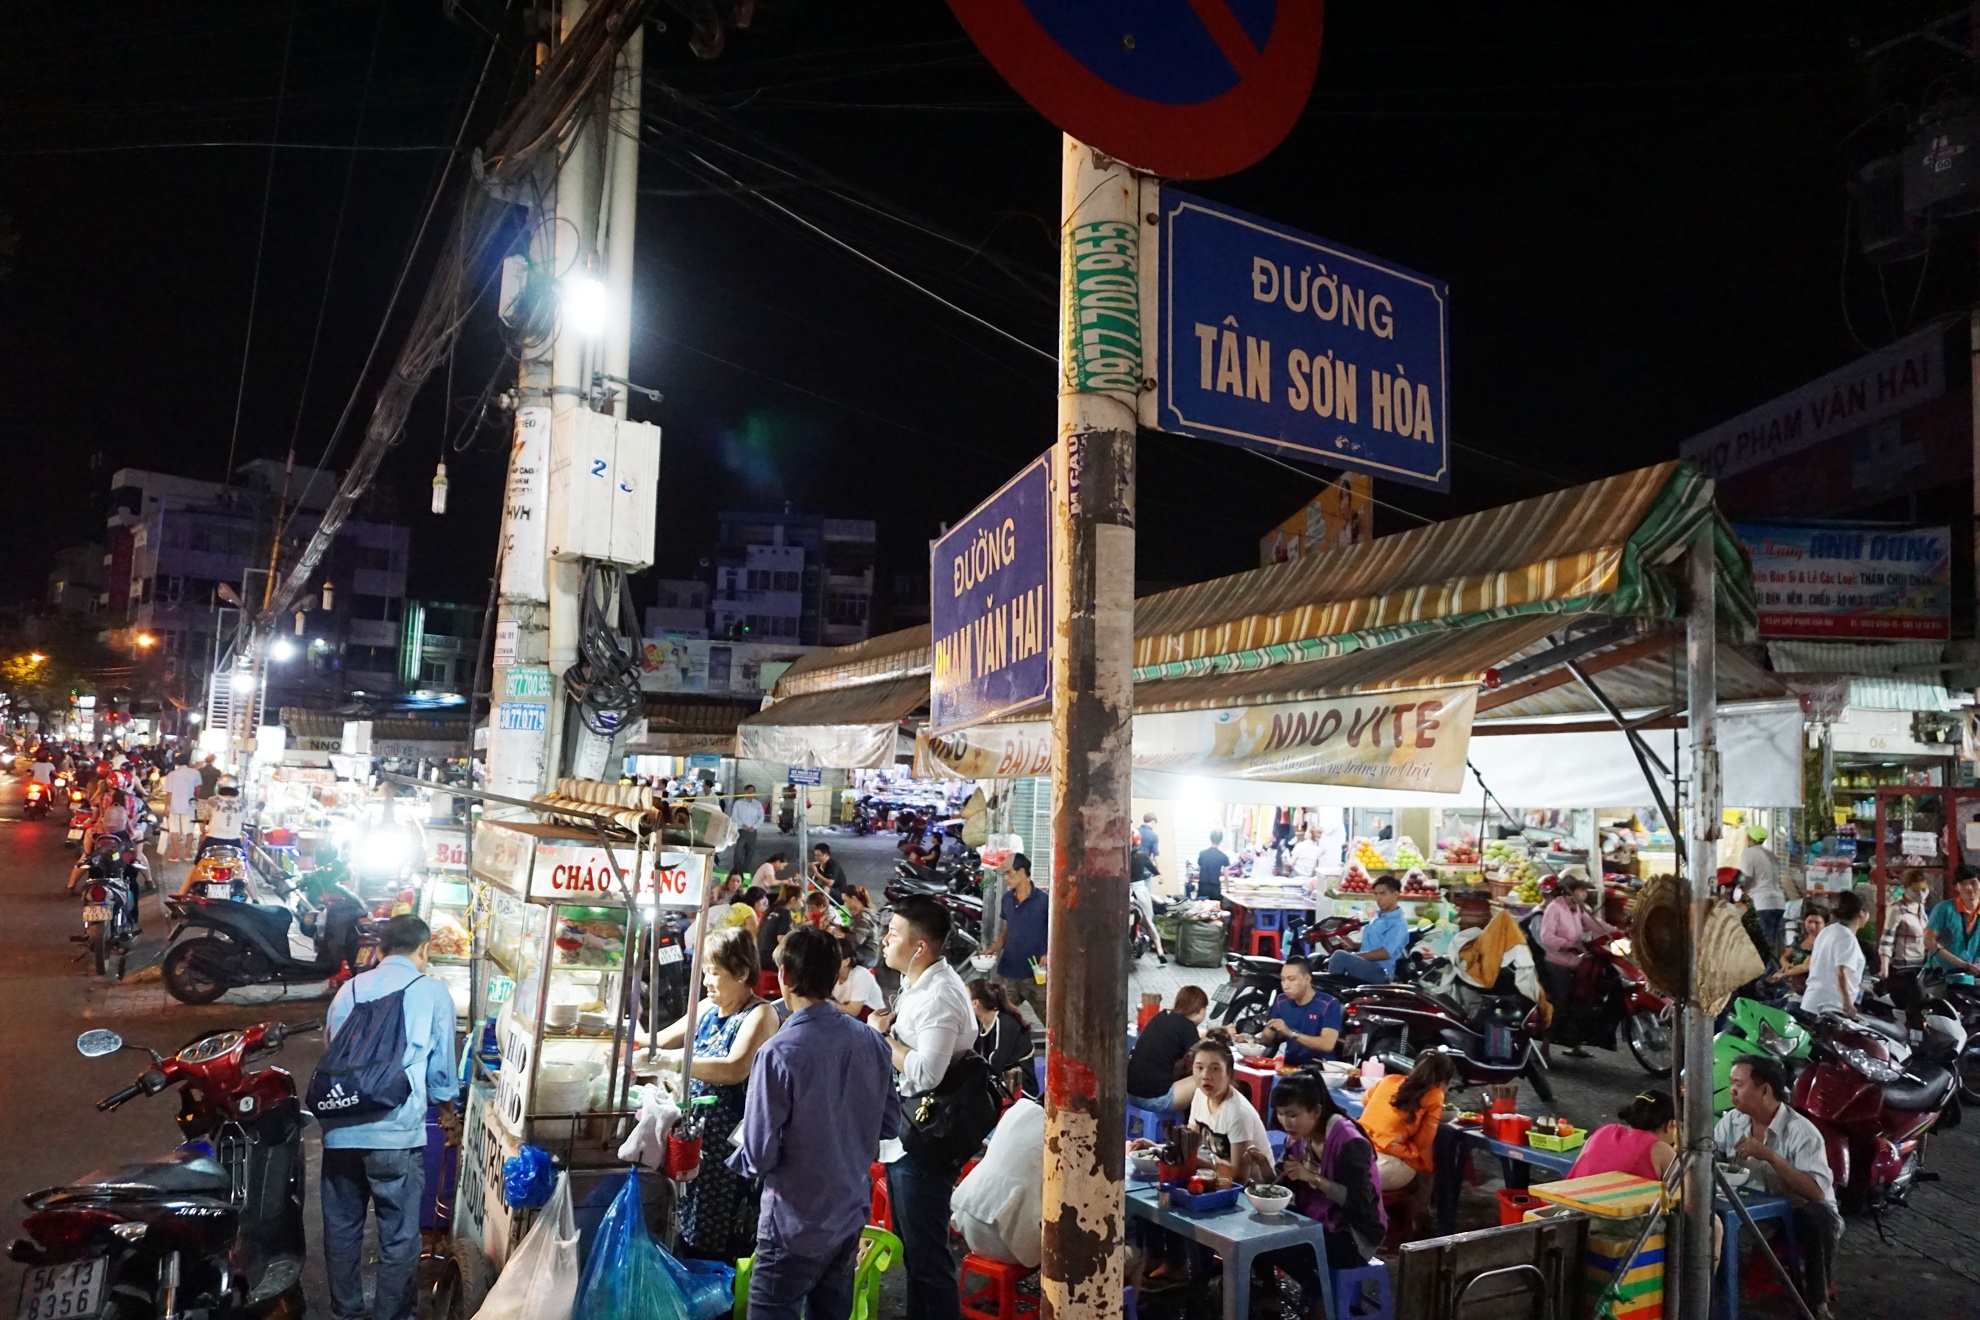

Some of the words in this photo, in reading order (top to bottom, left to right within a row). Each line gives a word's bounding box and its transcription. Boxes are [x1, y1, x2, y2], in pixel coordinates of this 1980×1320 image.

[1252, 256, 1394, 340] ĐƯỜNG
[1195, 315, 1271, 403] TÂN
[1288, 349, 1357, 424] SƠN
[1372, 364, 1435, 444] HÒA
[1737, 408, 1802, 458] PHẠM
[1811, 380, 1866, 429] VĂN
[1878, 353, 1930, 404] HAI
[591, 459, 607, 478] 2
[954, 518, 1015, 598] ĐƯỜNG
[935, 624, 972, 704] PHẠM
[975, 593, 1007, 680] VĂN
[1012, 585, 1043, 664] HAI
[310, 740, 341, 751] NNO
[1347, 700, 1444, 749] VITE
[1870, 737, 1887, 749] 06
[998, 730, 1031, 774] BÃI
[551, 857, 611, 892] CHÁO
[618, 868, 686, 894] TNG
[318, 1095, 359, 1110] adidas
[486, 1126, 509, 1216] TRẮN
